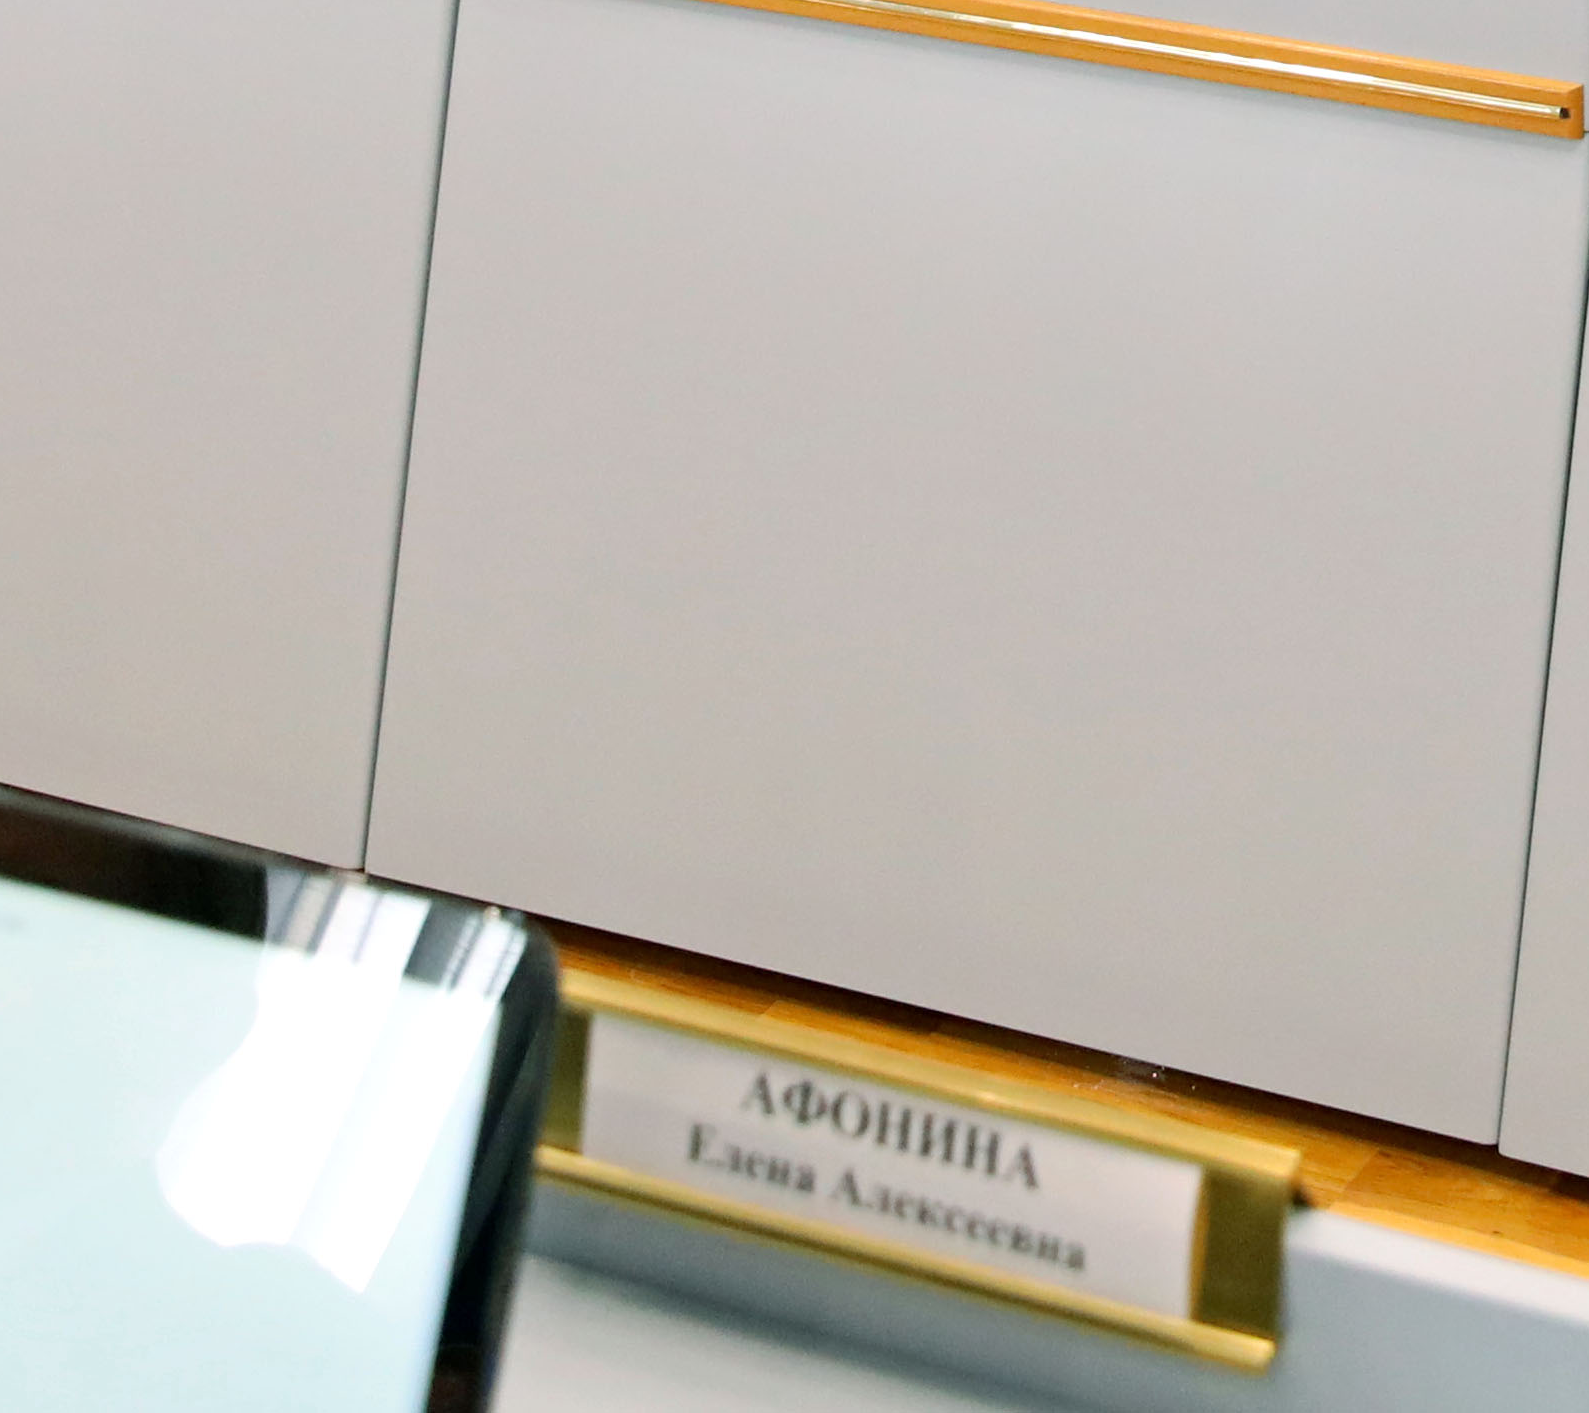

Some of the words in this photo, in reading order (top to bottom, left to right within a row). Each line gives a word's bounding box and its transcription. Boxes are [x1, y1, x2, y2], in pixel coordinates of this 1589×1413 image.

[687, 1123, 816, 1193] Елена
[833, 1168, 1086, 1272] Алексеевна
[741, 1071, 1040, 1191] АФОНИНА
